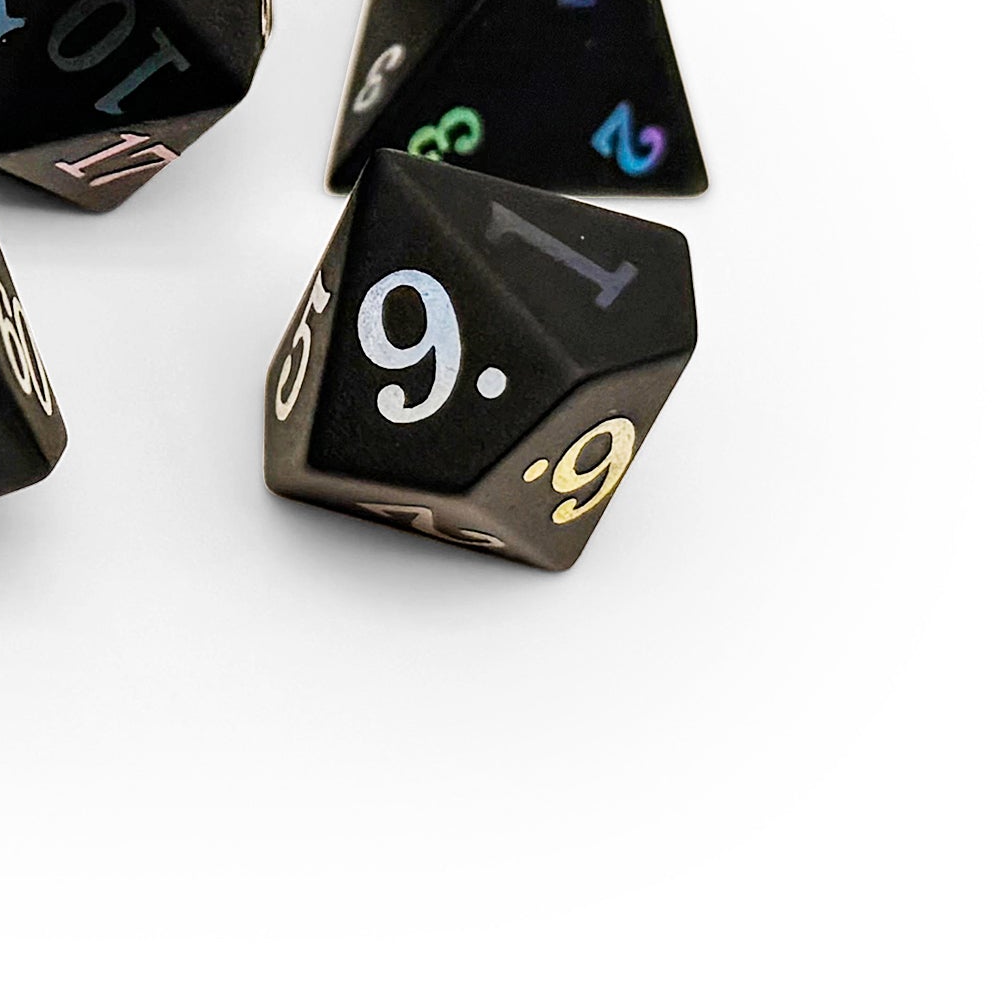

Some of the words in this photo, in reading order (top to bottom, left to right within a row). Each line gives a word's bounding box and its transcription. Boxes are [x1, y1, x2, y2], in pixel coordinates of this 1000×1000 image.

[55, 134, 180, 187] 17
[407, 106, 483, 161] 3
[591, 101, 668, 177] 2
[486, 202, 638, 307] 1
[275, 270, 331, 421] 5
